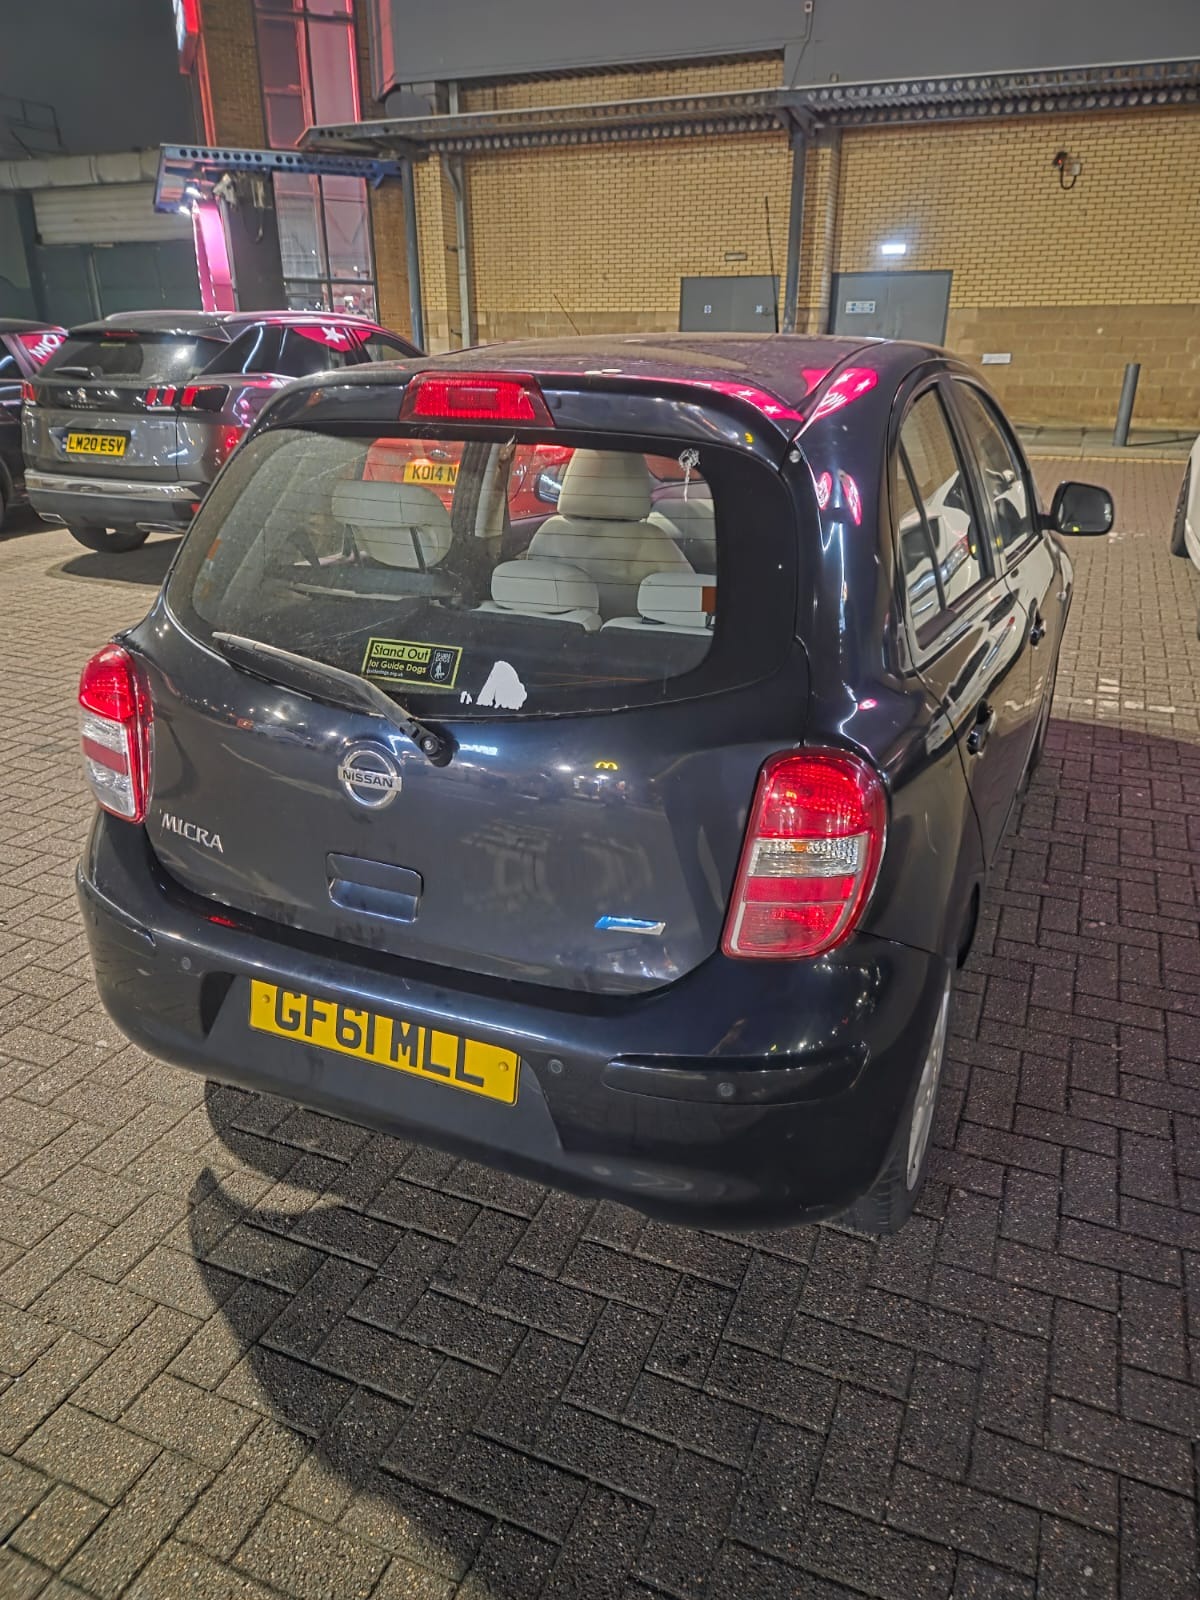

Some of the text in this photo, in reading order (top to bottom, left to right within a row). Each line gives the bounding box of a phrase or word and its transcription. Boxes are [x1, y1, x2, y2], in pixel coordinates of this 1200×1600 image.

[68, 436, 124, 452] LM20 ESV
[412, 464, 443, 481] KO14
[373, 645, 429, 661] Stand Out
[368, 659, 427, 674] for Guide Dogs
[342, 771, 393, 788] NISSAN
[161, 812, 224, 853] MICRA
[275, 987, 484, 1088] GF61 MLL
